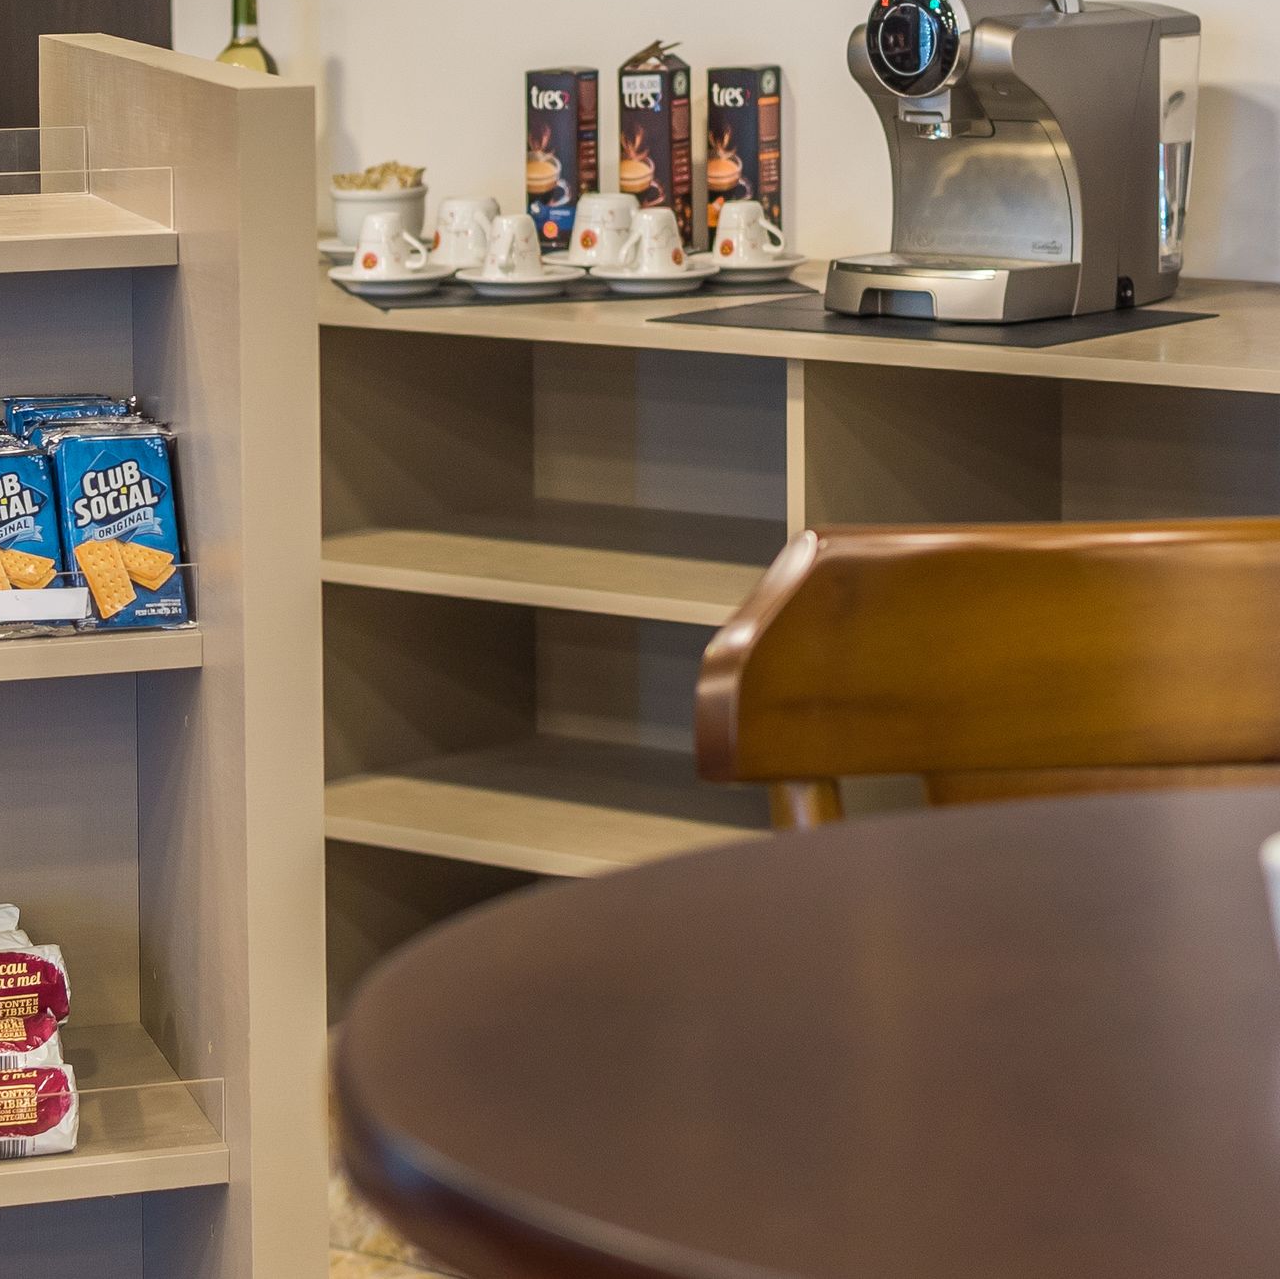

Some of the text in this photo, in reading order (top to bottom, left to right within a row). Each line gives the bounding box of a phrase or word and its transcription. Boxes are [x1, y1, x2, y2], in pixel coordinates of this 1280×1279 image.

[531, 85, 564, 111] tres
[712, 83, 745, 108] tres
[82, 460, 141, 498] CLUB
[98, 510, 150, 540] ORIGINAL
[17, 972, 42, 987] mel
[0, 997, 33, 1009] FONTE
[0, 1005, 39, 1018] FIBRAS
